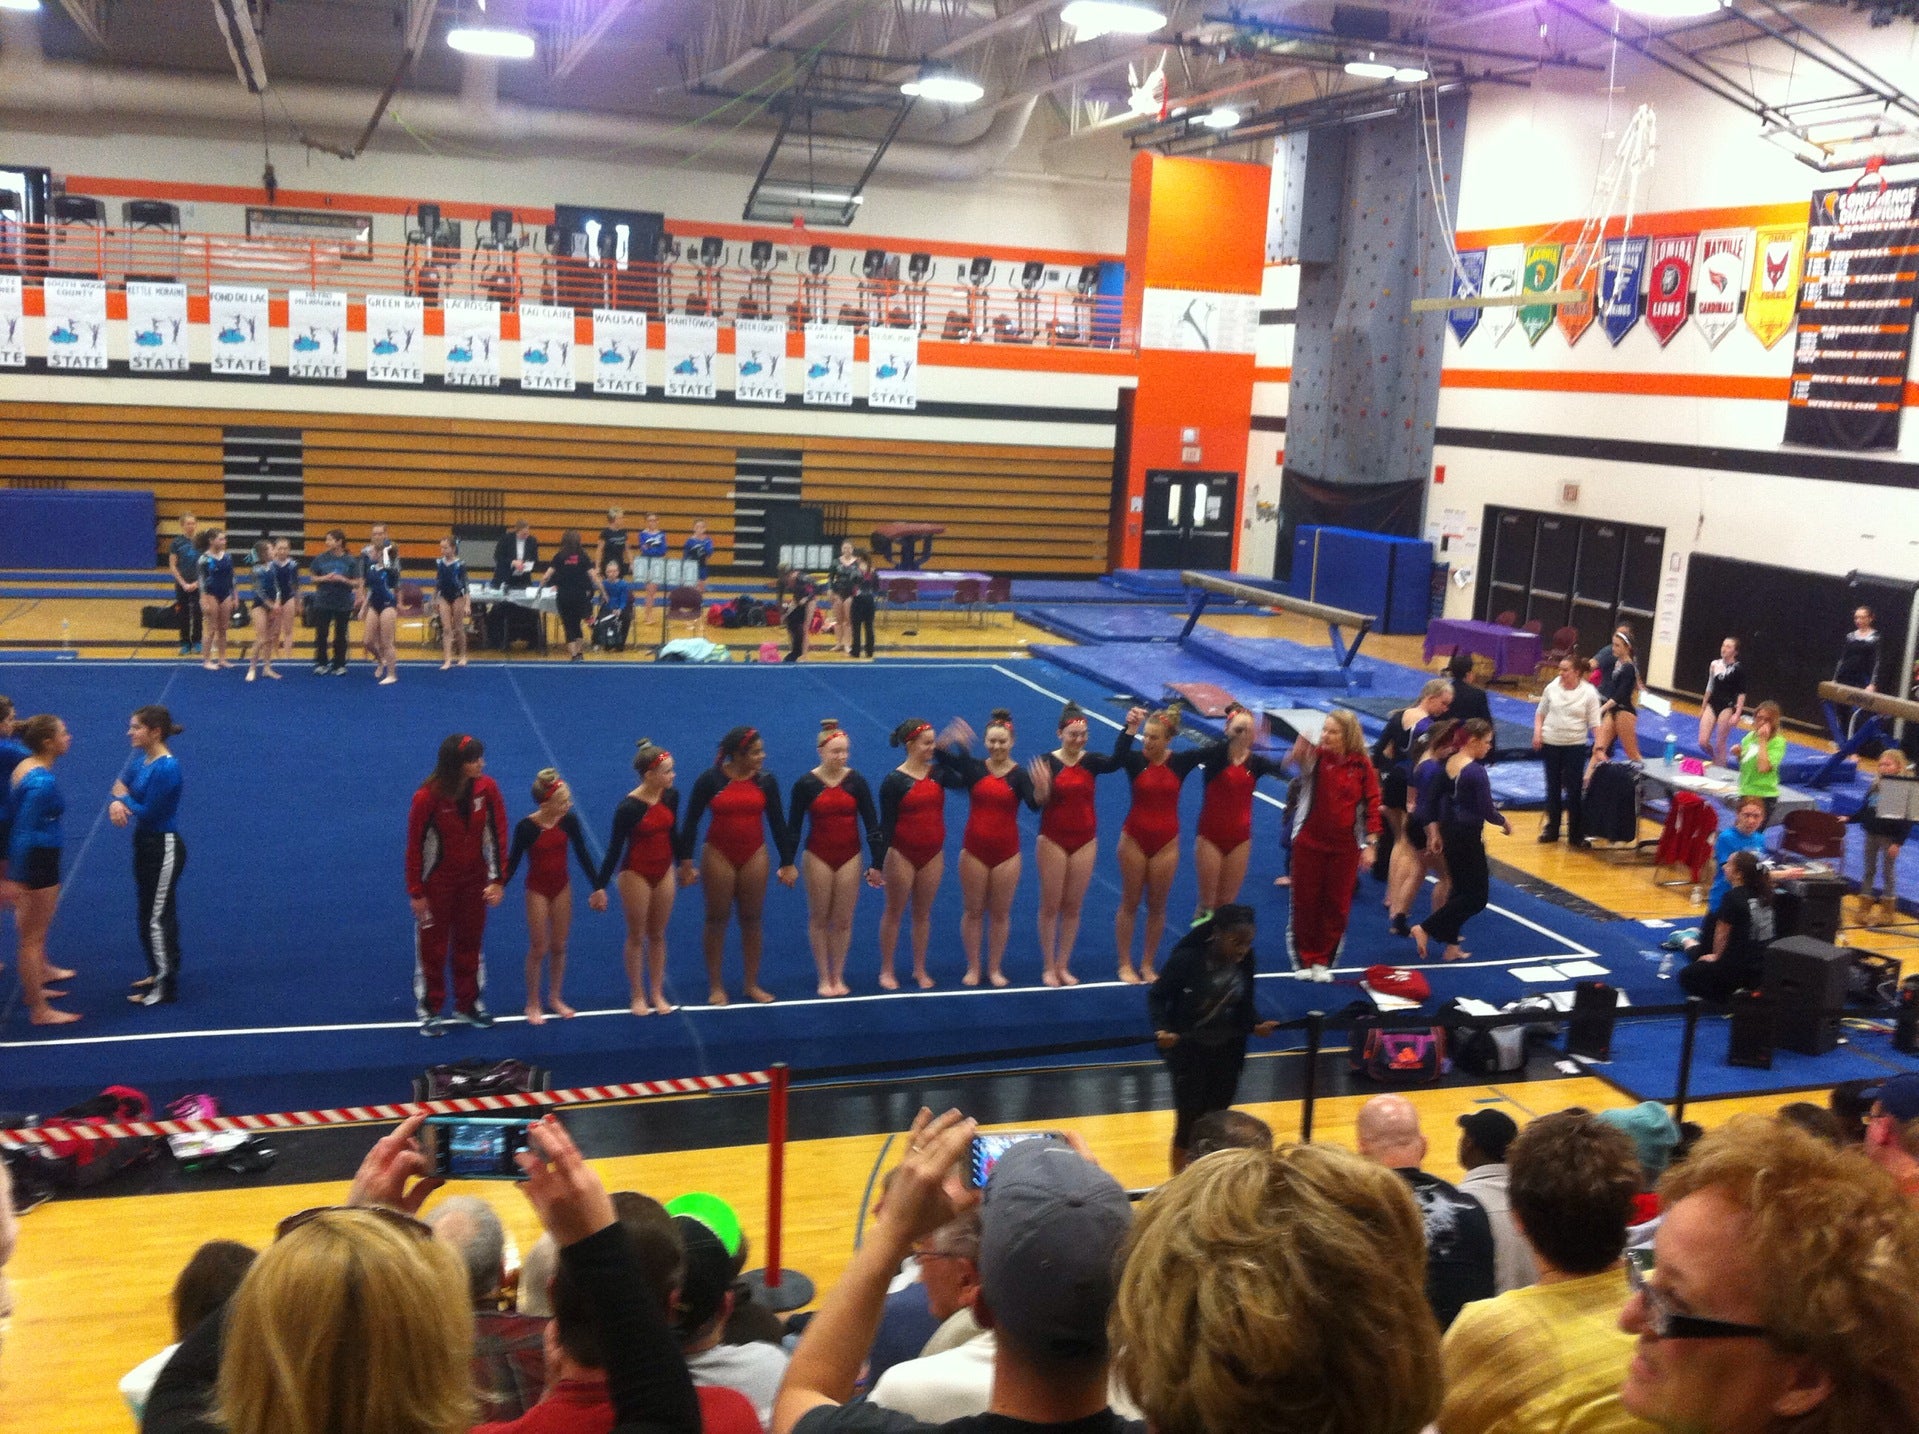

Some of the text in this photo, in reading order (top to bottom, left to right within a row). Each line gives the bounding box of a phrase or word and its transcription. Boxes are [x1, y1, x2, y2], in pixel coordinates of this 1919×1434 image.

[1652, 239, 1693, 267] LOMIRA
[1703, 237, 1744, 263] MAYVILLE
[368, 299, 422, 309] GREEN BAY
[1651, 301, 1682, 317] LIONS
[542, 310, 572, 319] CLAIRE
[595, 314, 643, 326] WAUSAU
[51, 355, 104, 368] STATE
[133, 357, 186, 369] STATE
[214, 357, 267, 371] STATE
[292, 364, 341, 378] STATE
[370, 366, 422, 379] STATE
[446, 372, 498, 386] STATE
[523, 375, 573, 389] STATE
[596, 378, 644, 392] STATE
[669, 382, 713, 396] STATE
[738, 386, 784, 400] STATE
[806, 389, 851, 403] STATE
[871, 392, 915, 406] STATE
